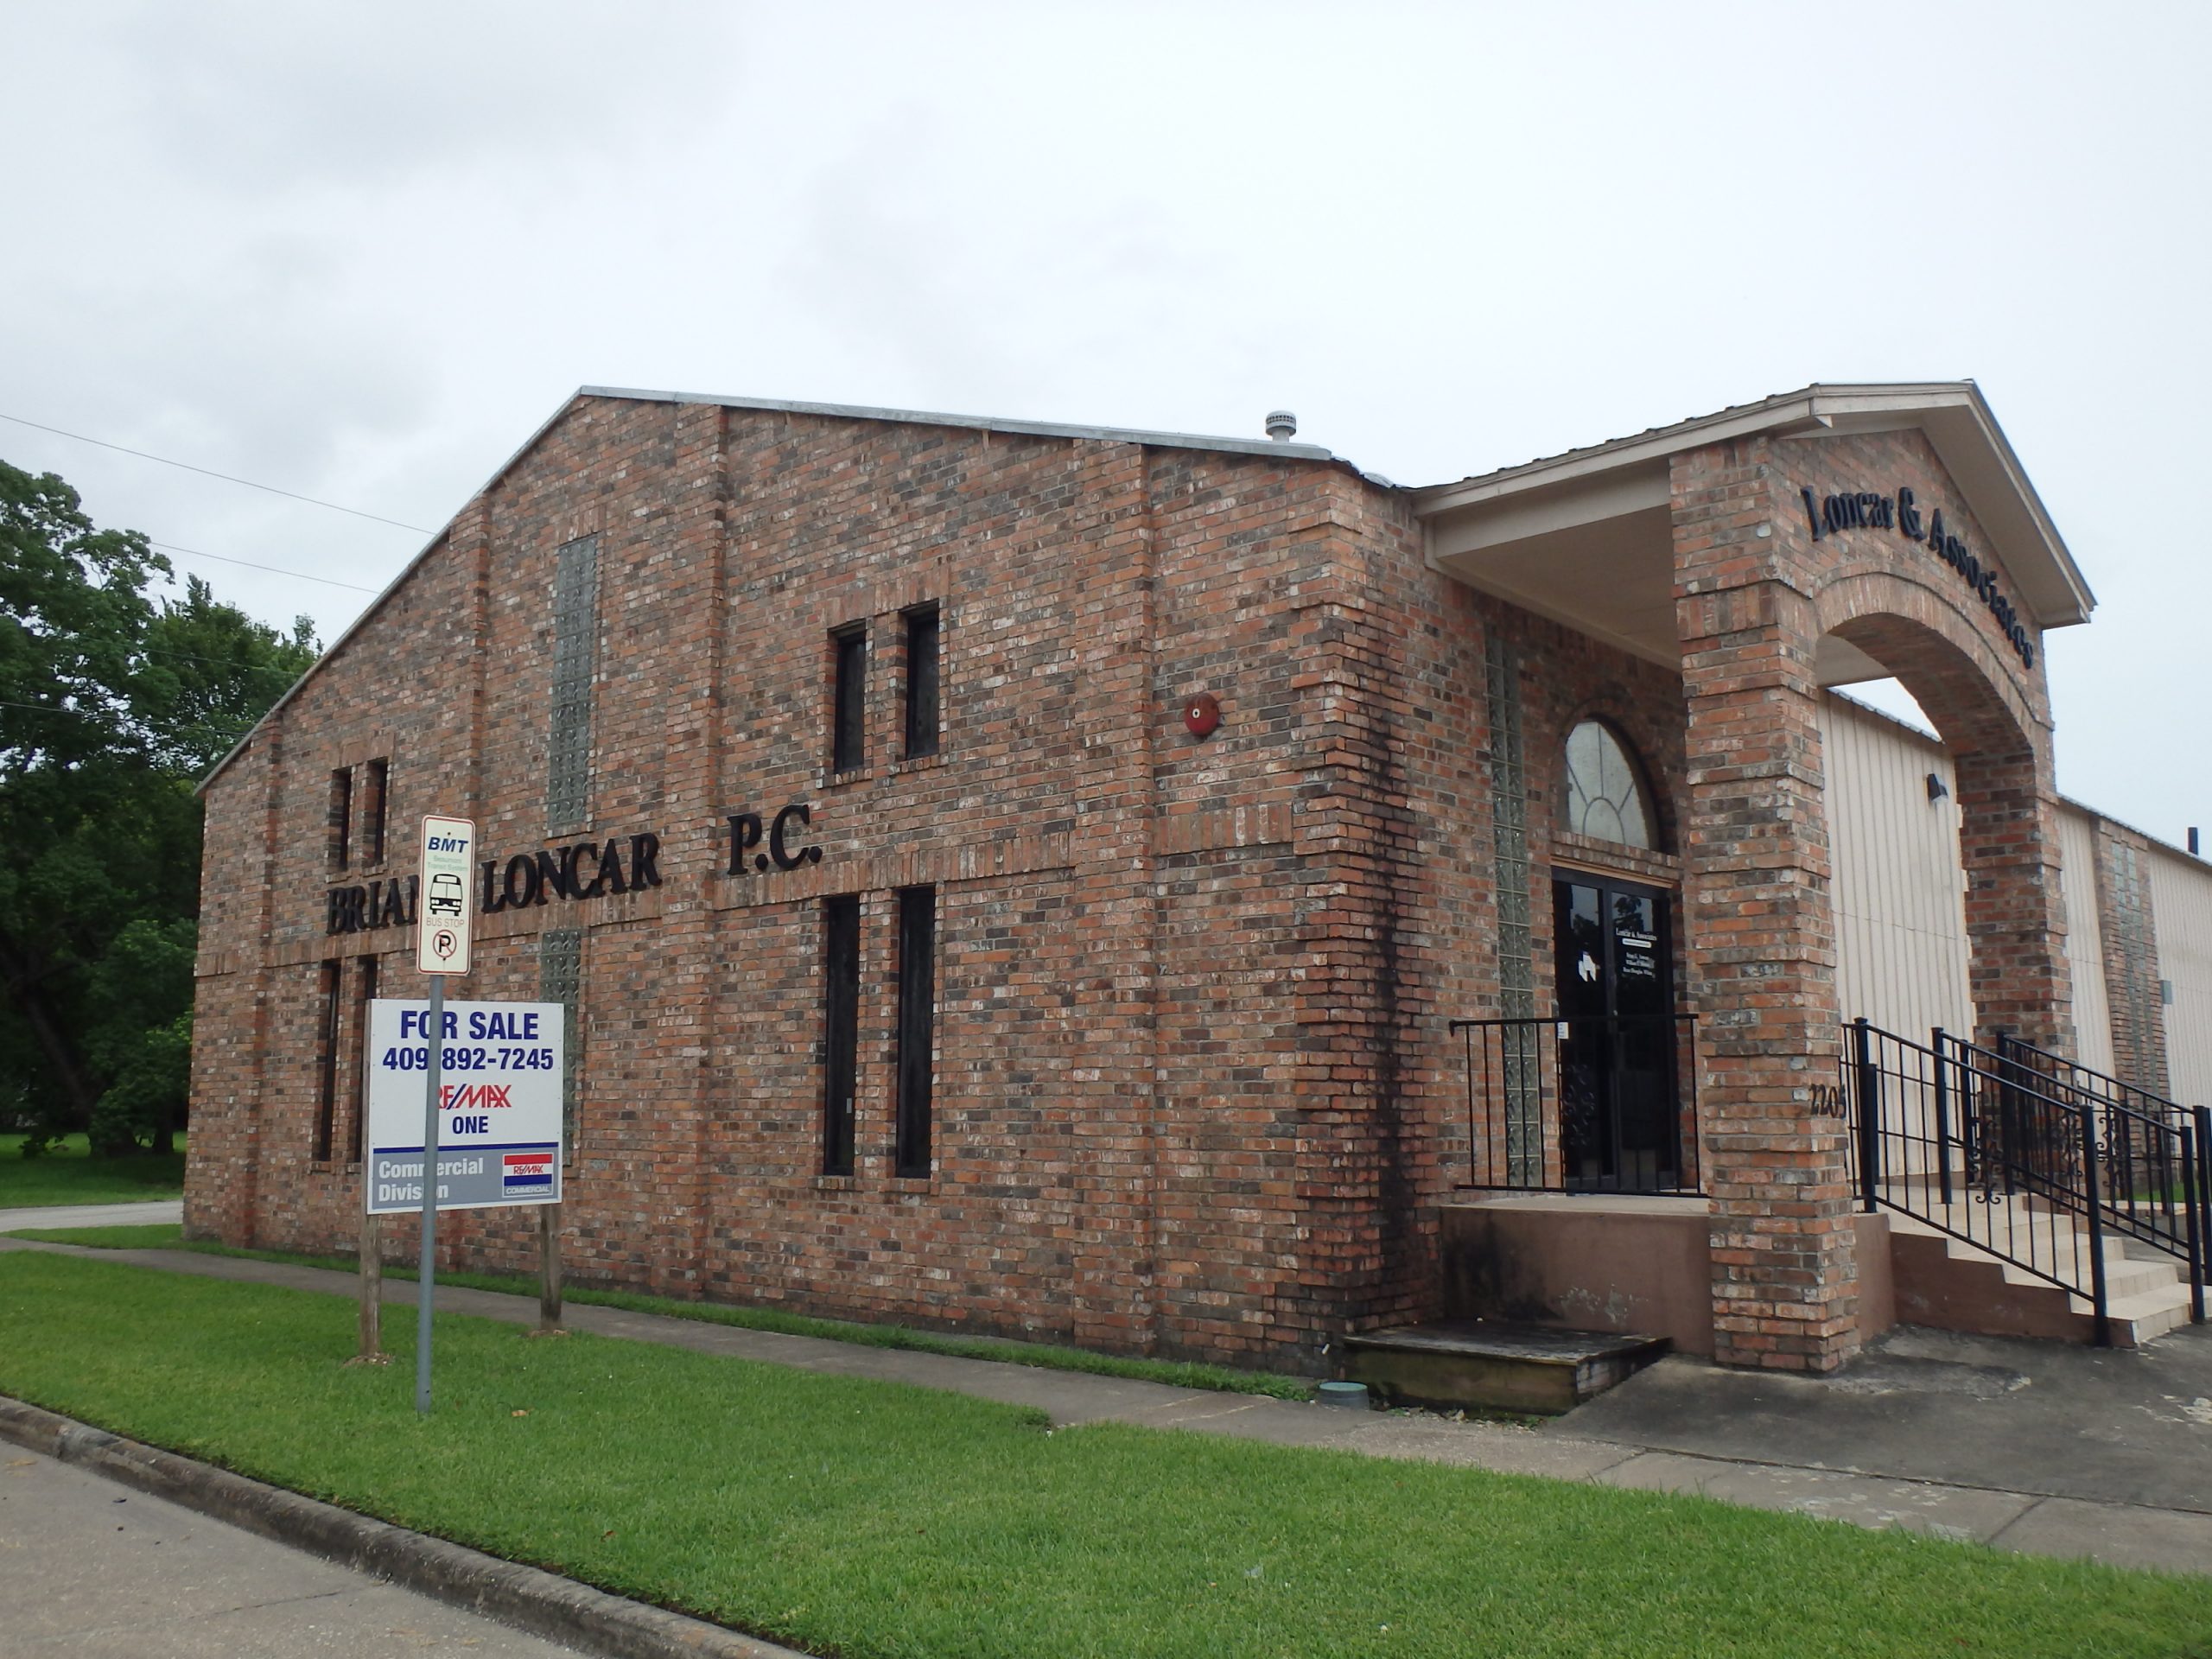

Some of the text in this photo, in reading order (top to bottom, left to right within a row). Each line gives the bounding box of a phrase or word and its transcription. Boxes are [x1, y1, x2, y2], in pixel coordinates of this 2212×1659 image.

[1800, 485, 2034, 670] Loncar & Associates
[428, 836, 468, 853] BMT
[480, 832, 662, 914] LONCAR
[727, 804, 823, 875] P.C.
[426, 917, 464, 927] BUS STOP
[469, 1012, 539, 1040] SALE
[452, 1116, 488, 1135] ONE
[513, 1164, 543, 1175] RE/MAX
